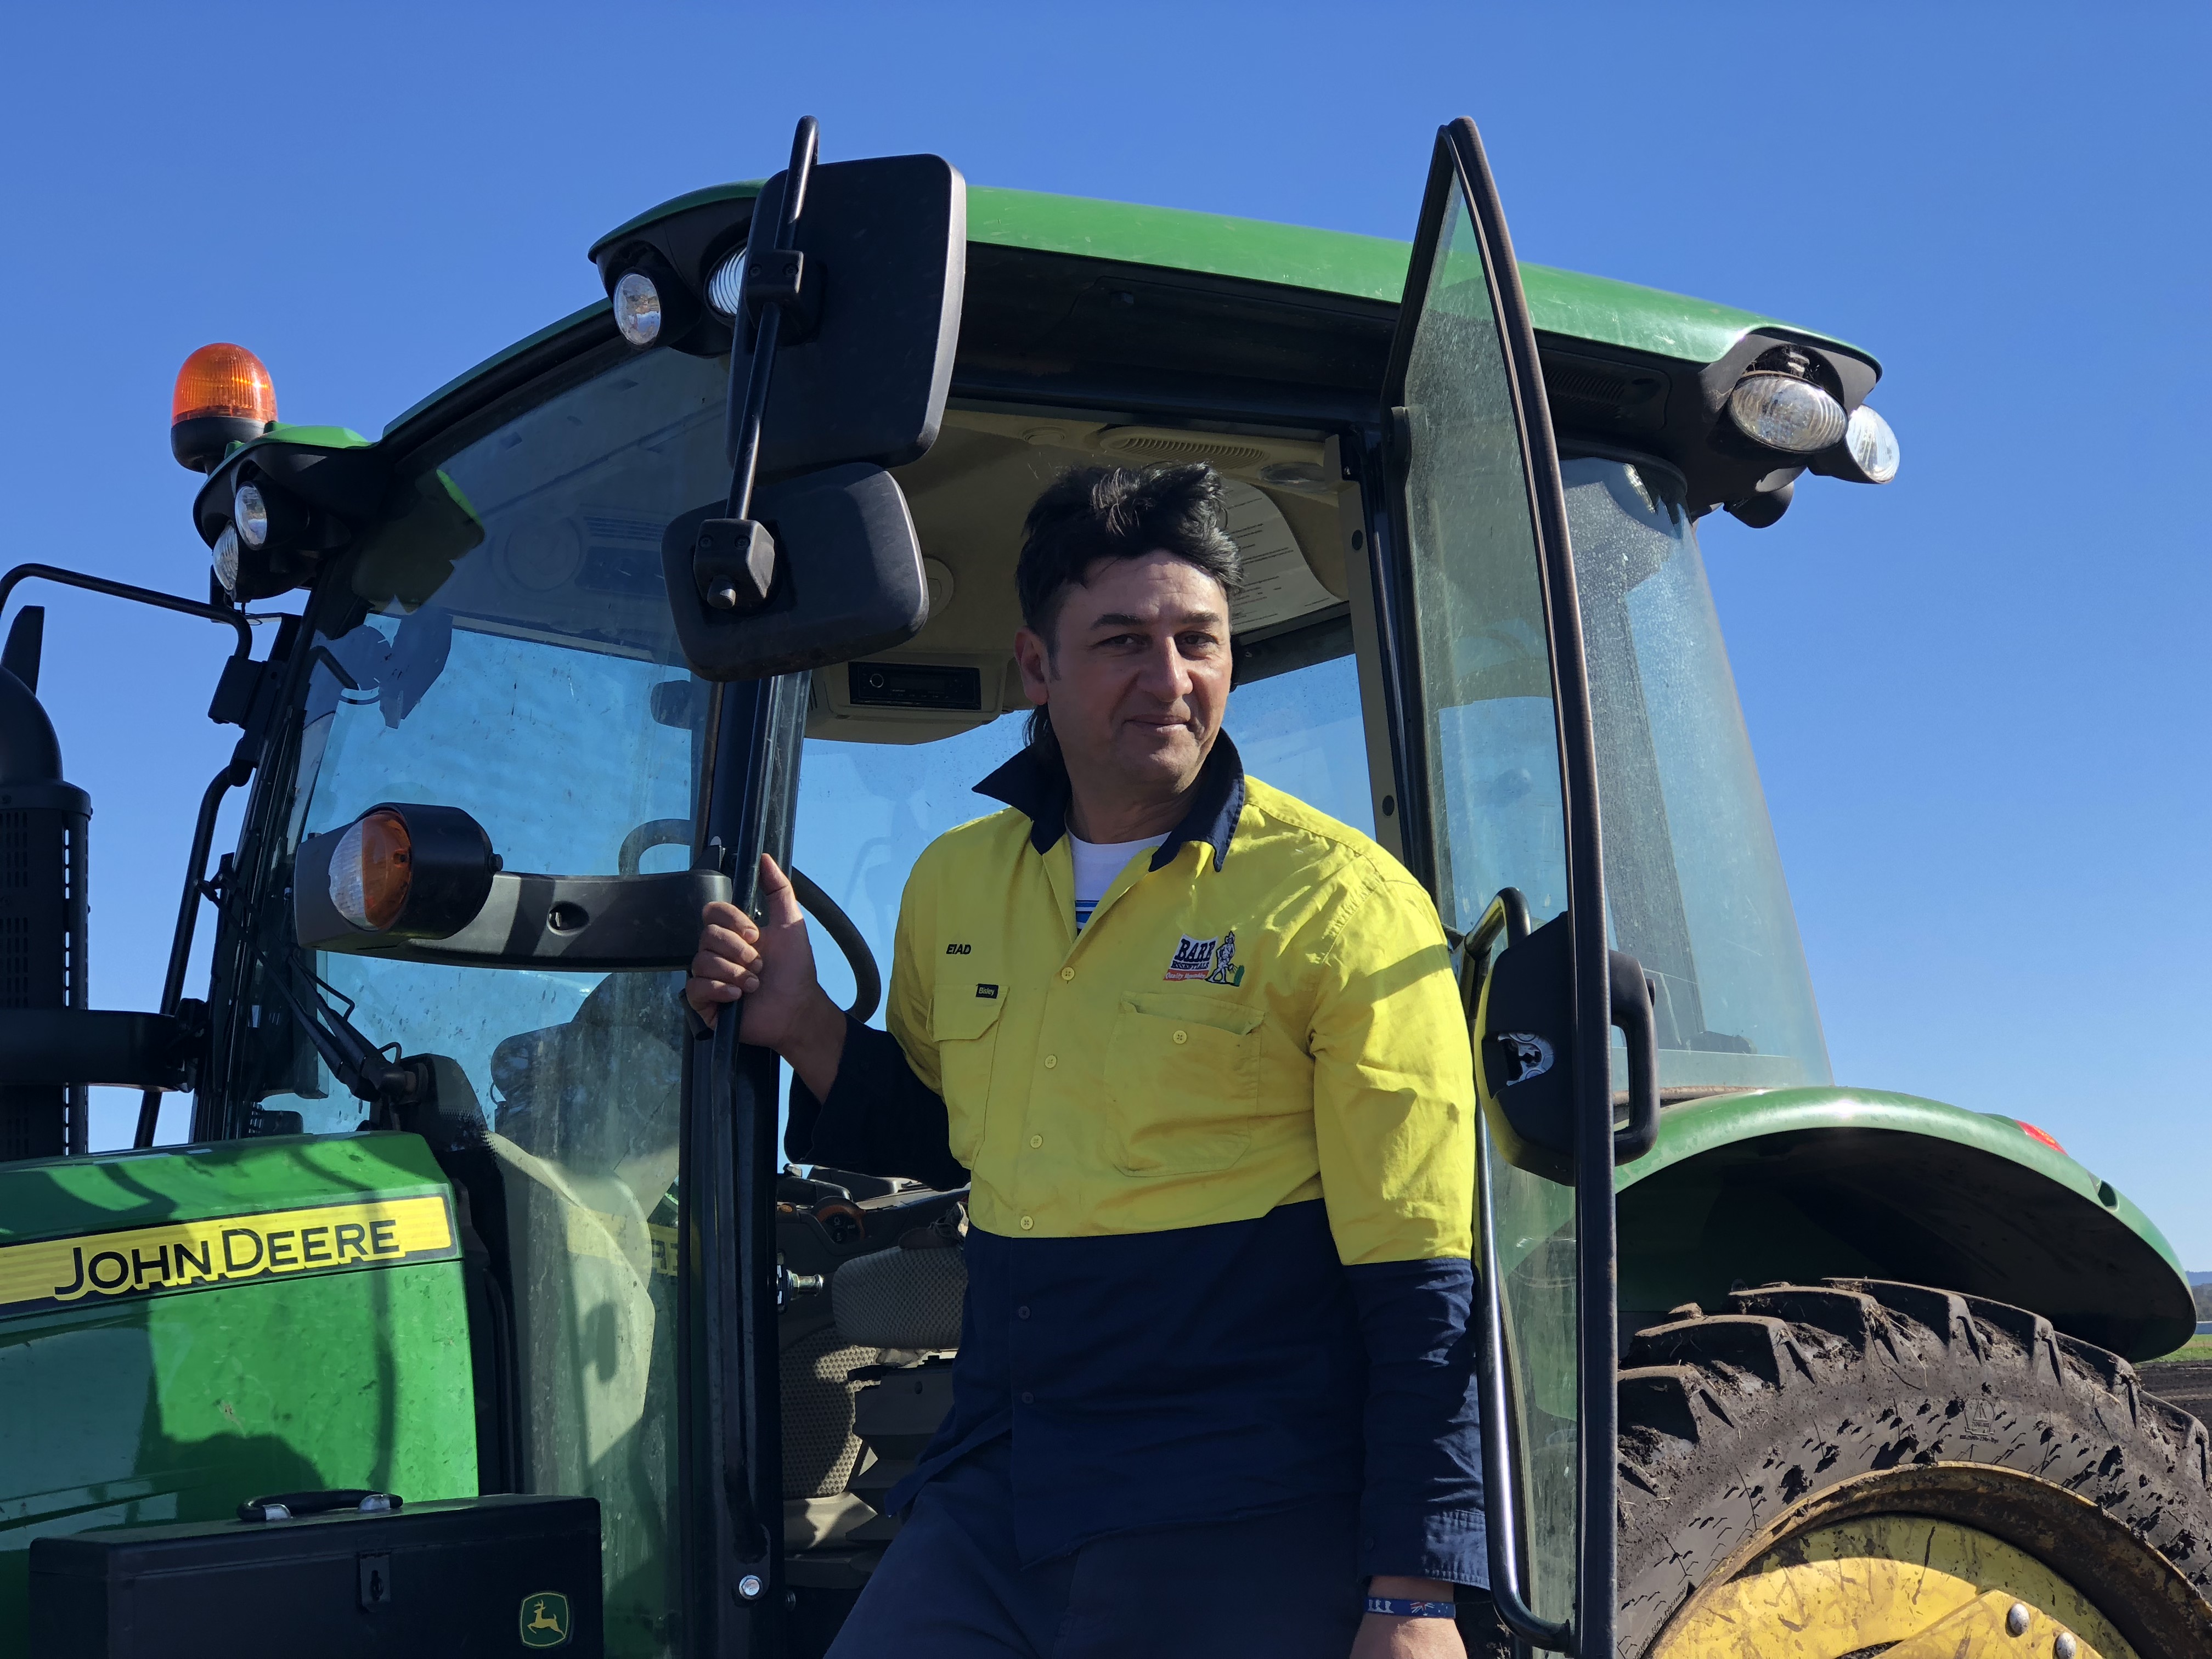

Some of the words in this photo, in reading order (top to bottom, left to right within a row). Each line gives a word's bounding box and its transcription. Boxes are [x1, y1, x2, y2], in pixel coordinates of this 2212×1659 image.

[946, 944, 972, 955] EIAD
[979, 987, 995, 996] Bisley
[54, 1240, 212, 1295] JOHN
[222, 1220, 400, 1273] DEERE
